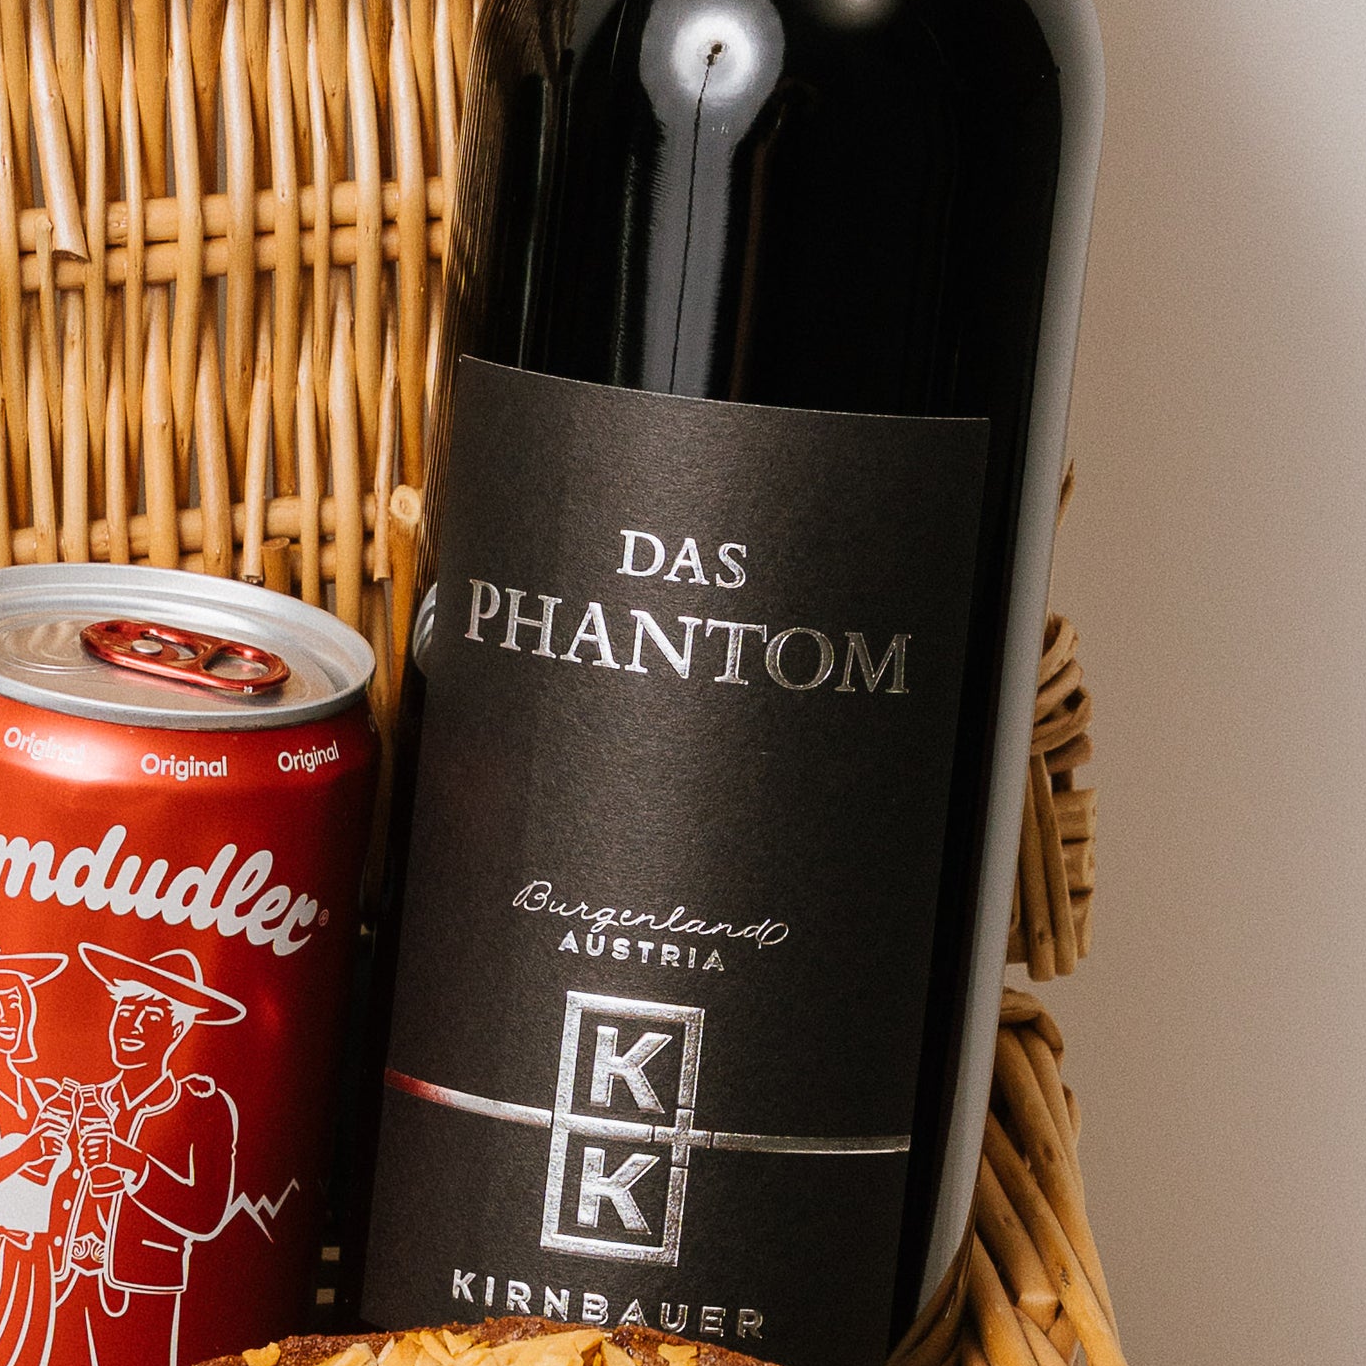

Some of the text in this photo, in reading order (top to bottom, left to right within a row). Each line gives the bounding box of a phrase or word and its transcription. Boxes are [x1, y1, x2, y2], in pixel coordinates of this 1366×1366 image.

[616, 528, 748, 590] DAS
[463, 577, 913, 695] PHANTOM
[3, 726, 85, 766] Original
[140, 752, 228, 781] Original
[276, 740, 340, 774] Original
[512, 879, 790, 949] Burgenland
[558, 930, 726, 972] AUSTRIA
[588, 1024, 673, 1113] K
[576, 1146, 660, 1235] K
[451, 1268, 765, 1340] KIRNBAUER
